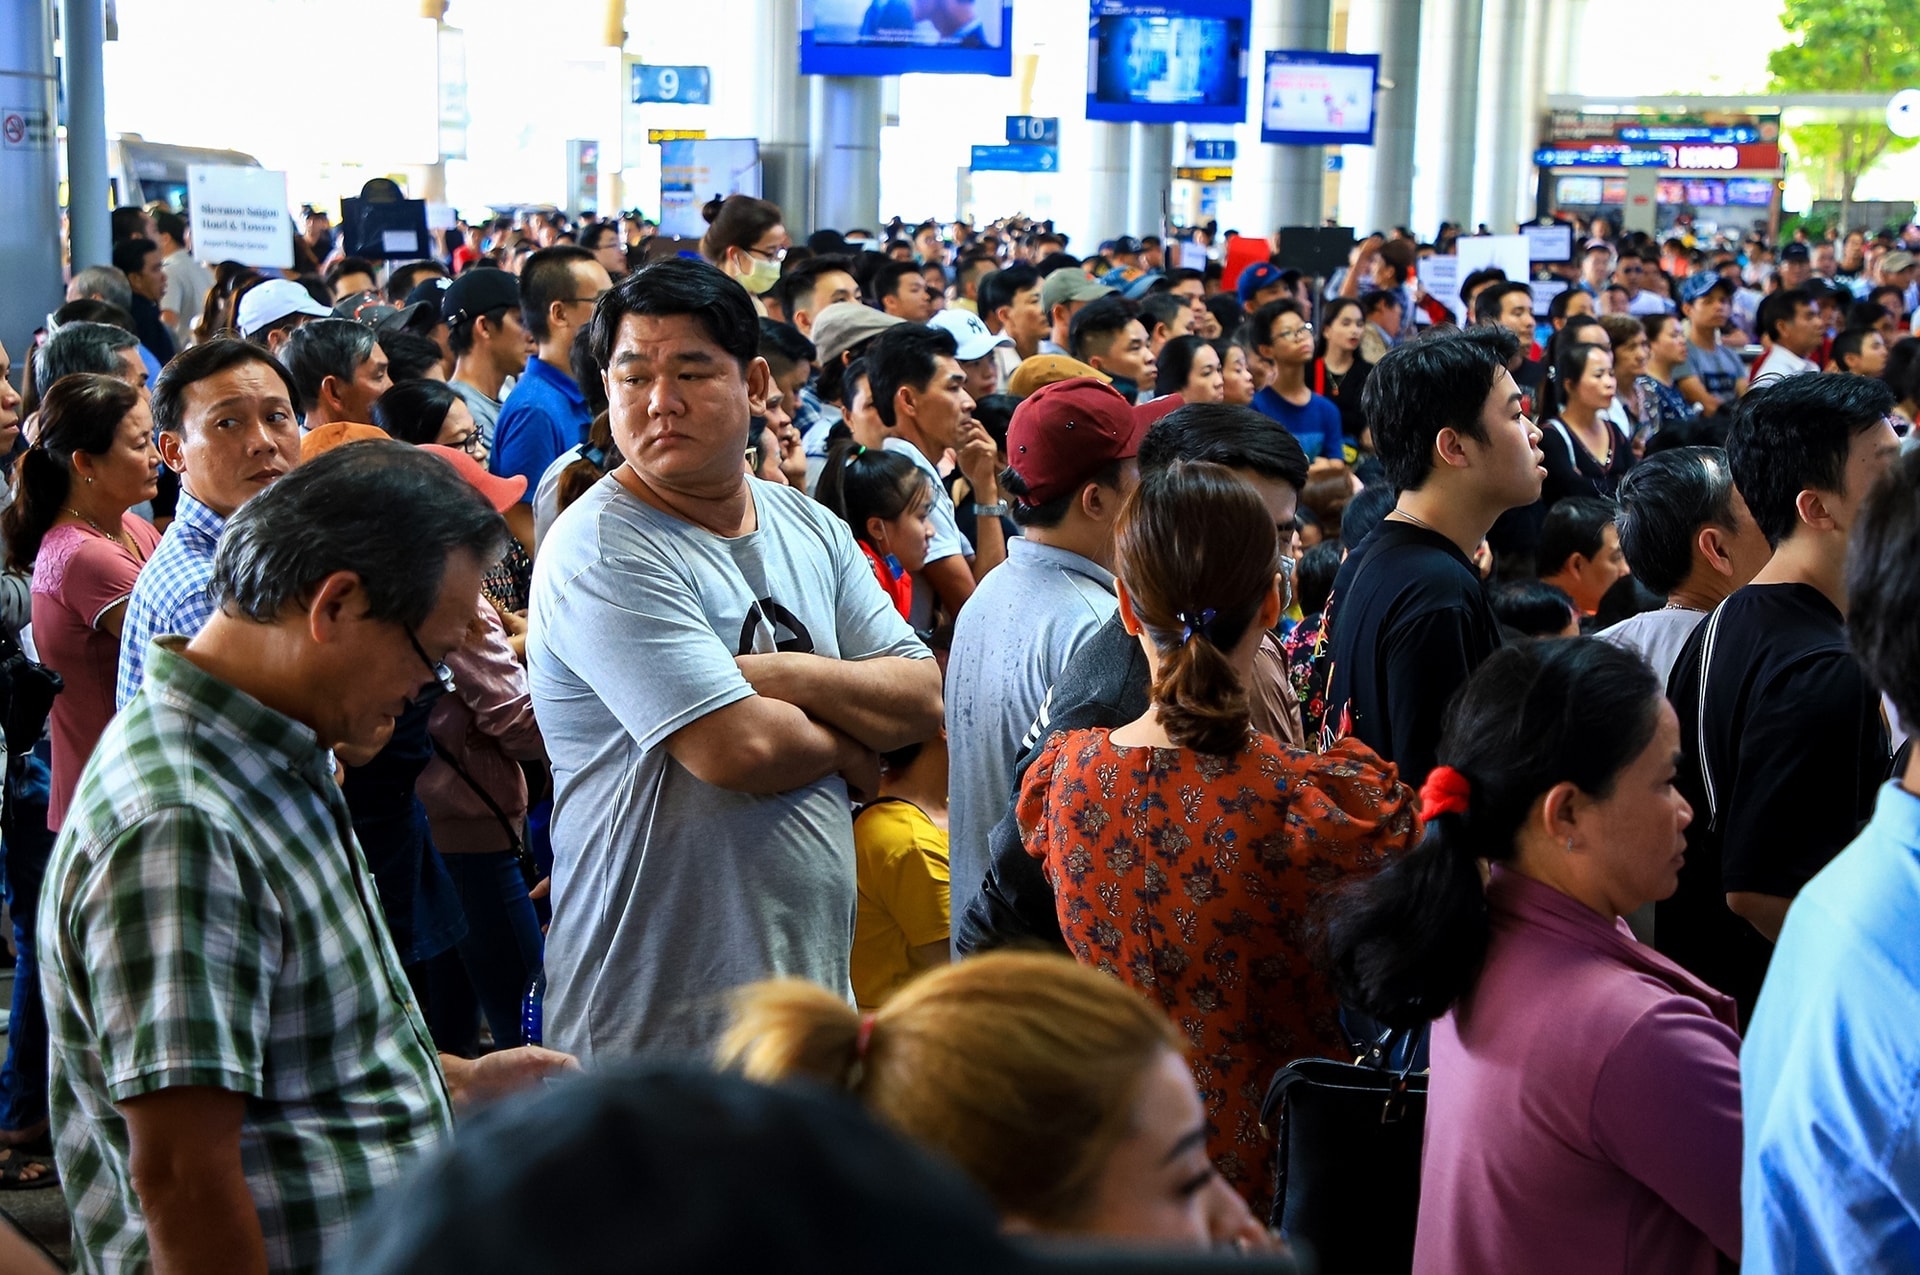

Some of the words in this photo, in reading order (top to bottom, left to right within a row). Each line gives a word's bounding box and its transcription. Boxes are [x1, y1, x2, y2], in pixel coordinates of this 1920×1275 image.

[658, 69, 679, 100] 9
[1018, 118, 1044, 139] 10
[1206, 143, 1225, 159] 11
[201, 203, 245, 216] Sheraton
[247, 207, 279, 219] Saigon
[202, 219, 228, 230] Hotel
[230, 221, 237, 231] &
[241, 221, 277, 232] Towers
